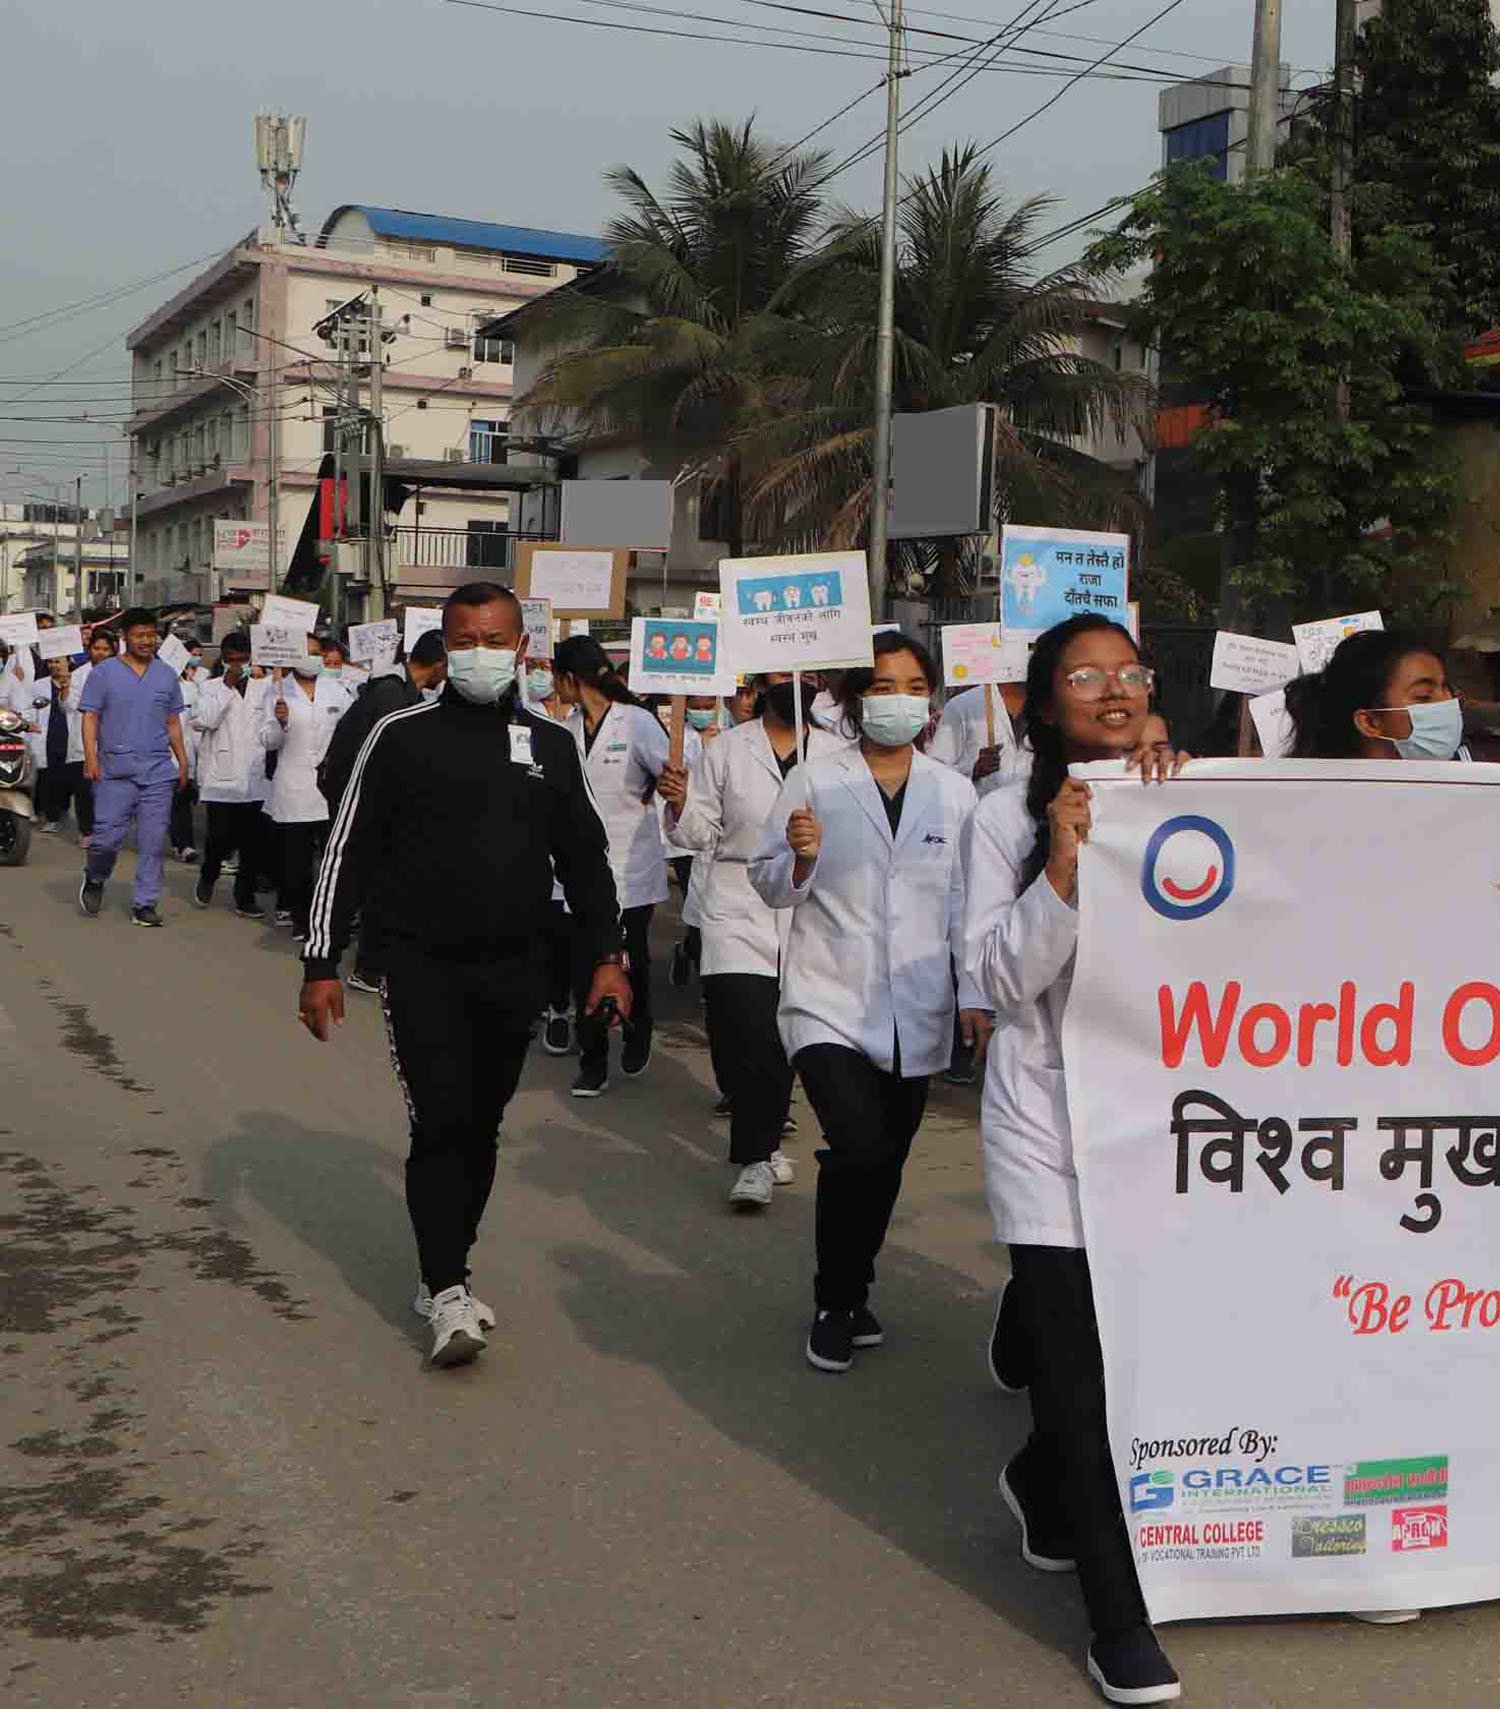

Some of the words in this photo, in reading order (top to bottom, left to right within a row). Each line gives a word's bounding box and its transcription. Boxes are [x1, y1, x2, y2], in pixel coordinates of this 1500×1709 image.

[1078, 573, 1101, 586] राजा
[1158, 981, 1415, 1068] World
[1170, 1089, 1358, 1194] विश्व
[1129, 1426, 1239, 1470] Sponsored
[1239, 1429, 1278, 1463] By:
[1182, 1465, 1331, 1489] GRACE
[1181, 1484, 1332, 1499] INTERNATIONAL
[1140, 1523, 1199, 1547] CENTRAL
[1203, 1520, 1263, 1544] COLLEGE
[1150, 1547, 1194, 1562] VOCATIONAL
[1196, 1547, 1229, 1560] TRAINING
